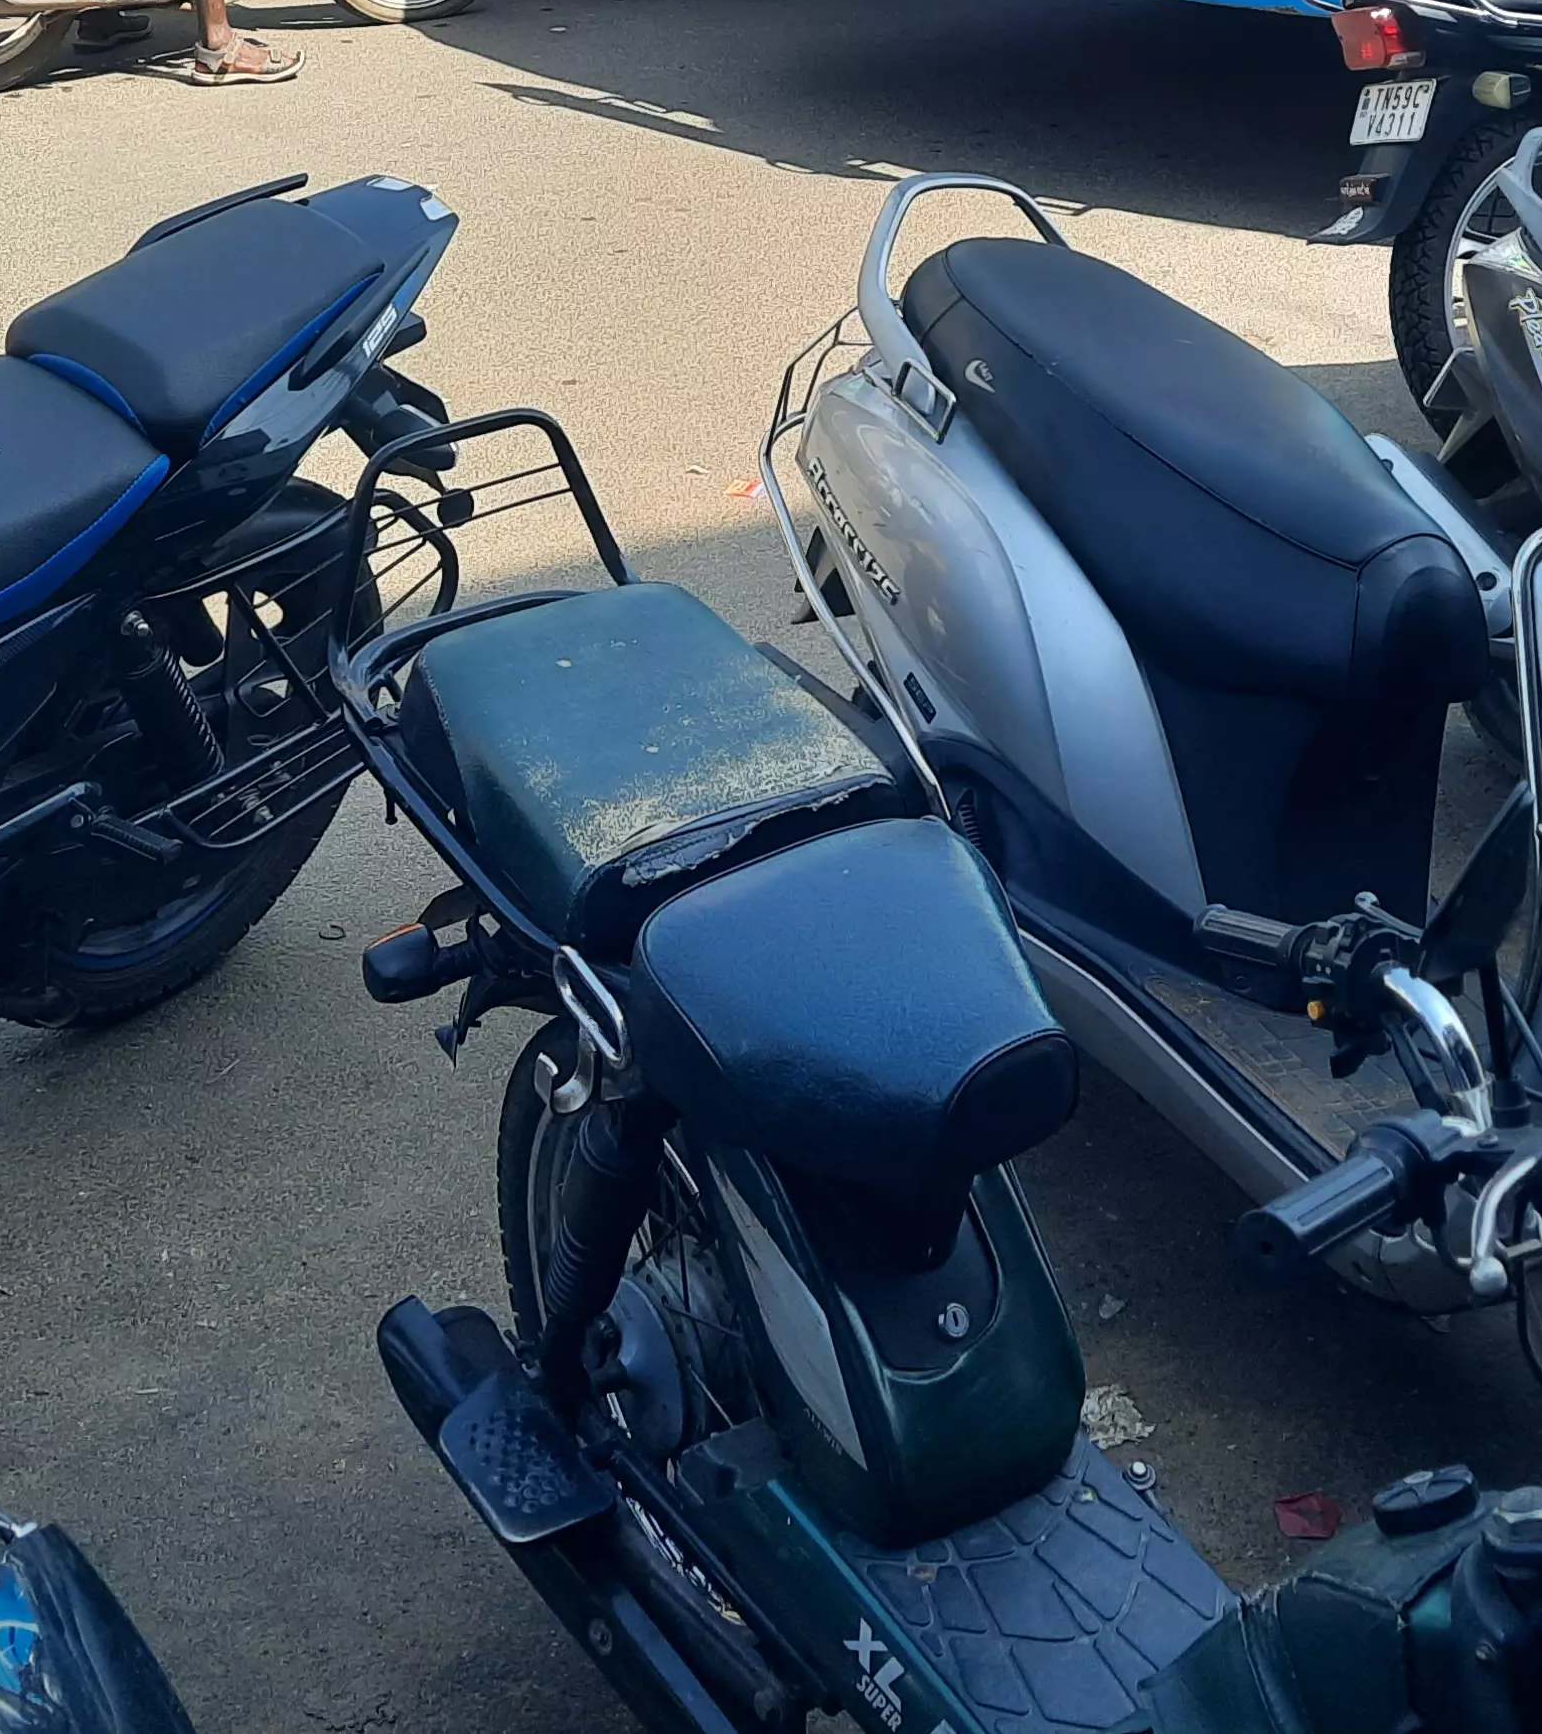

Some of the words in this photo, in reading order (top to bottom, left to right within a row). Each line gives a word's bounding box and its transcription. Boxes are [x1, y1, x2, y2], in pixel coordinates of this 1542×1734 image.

[362, 303, 398, 359] 125
[843, 1616, 912, 1711] XL
[855, 1673, 904, 1734] SUPER
